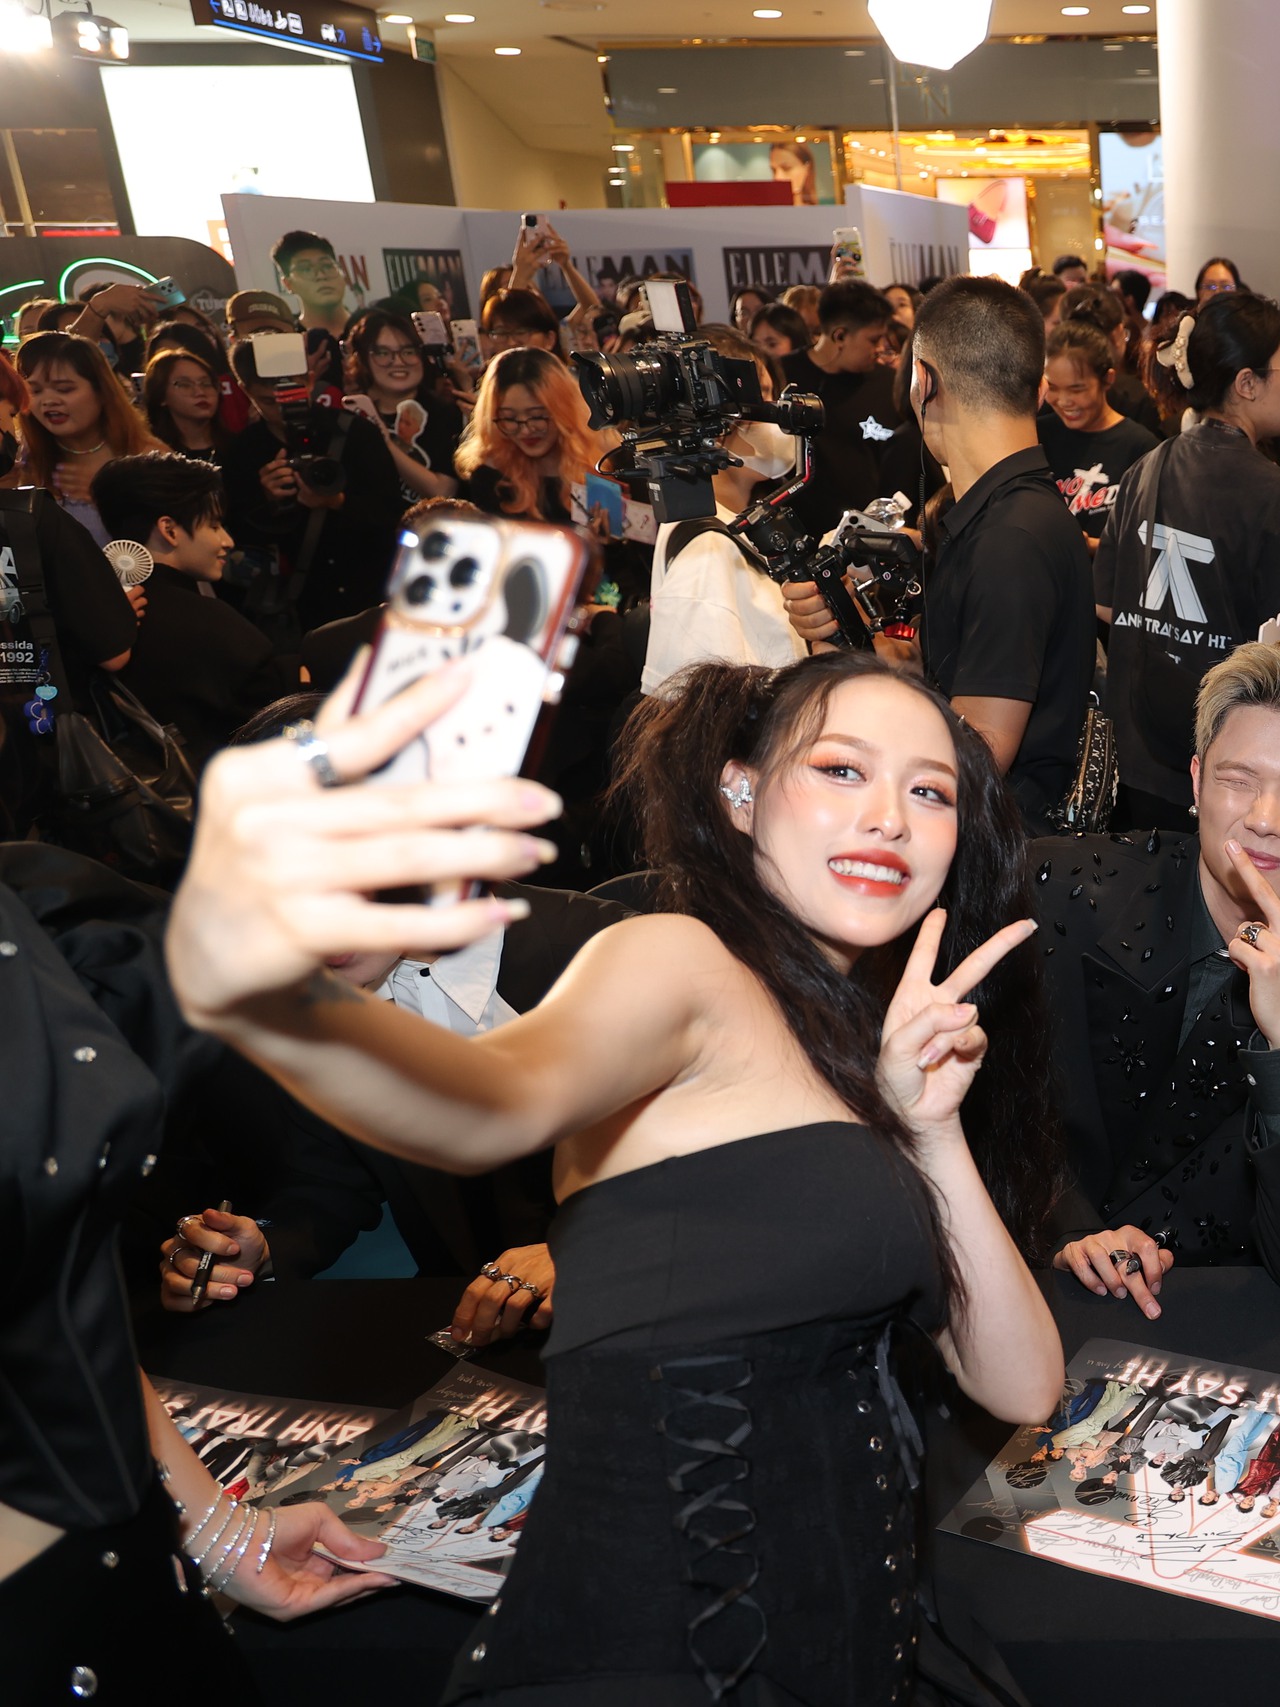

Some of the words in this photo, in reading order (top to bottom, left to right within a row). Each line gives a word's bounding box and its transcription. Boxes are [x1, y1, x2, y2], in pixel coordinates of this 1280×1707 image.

[729, 251, 831, 287] ELLEM
[0, 640, 34, 650] ssida
[0, 651, 35, 664] 1992
[182, 1406, 277, 1437] TRAI
[277, 1419, 372, 1446] ANH
